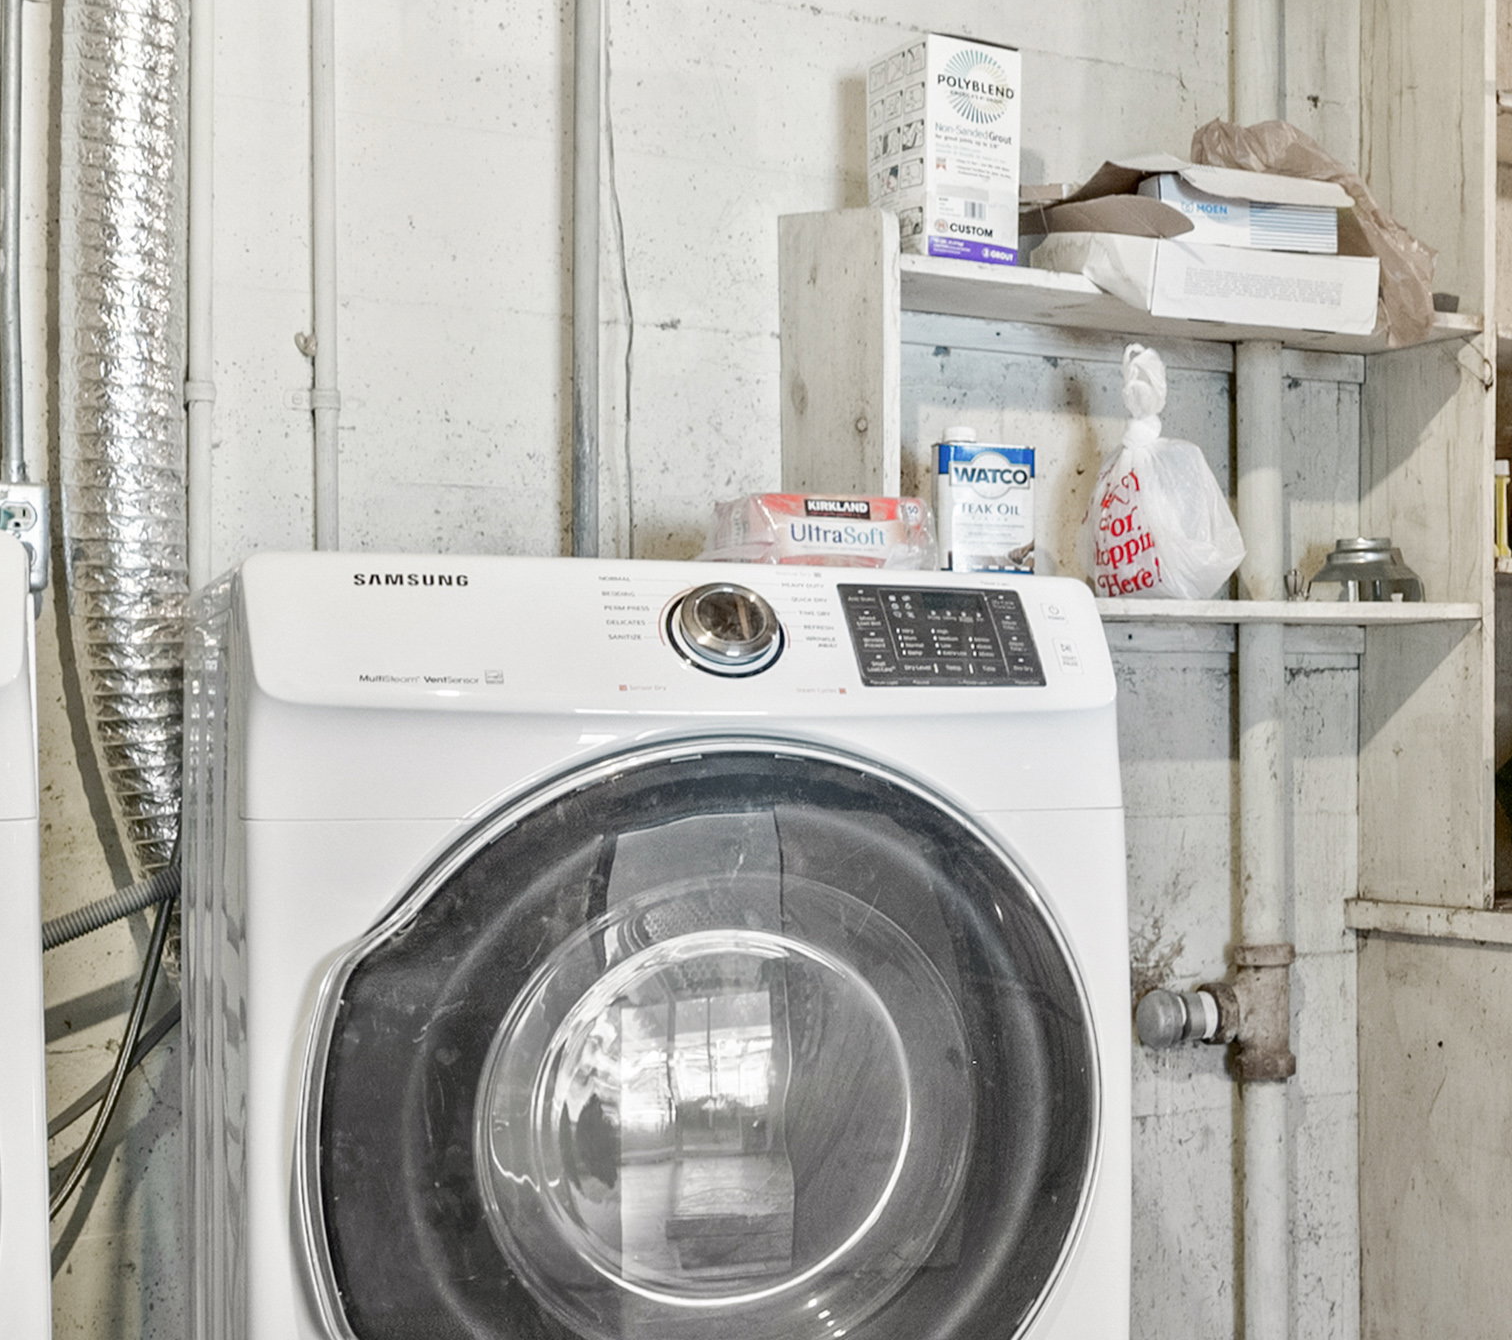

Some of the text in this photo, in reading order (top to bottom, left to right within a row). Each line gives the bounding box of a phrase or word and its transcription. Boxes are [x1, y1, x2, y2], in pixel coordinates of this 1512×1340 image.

[937, 73, 1015, 100] POLYBLEND
[1196, 202, 1228, 215] MOEN
[949, 222, 994, 238] CUSTOM
[954, 467, 1028, 485] WATCO
[807, 499, 869, 513] KIRKLAND
[961, 503, 994, 515] TEAK
[790, 523, 886, 546] UltraSoft
[353, 573, 470, 587] SAMSUNG
[1097, 557, 1164, 598] Here!
[423, 675, 480, 685] VentSensor
